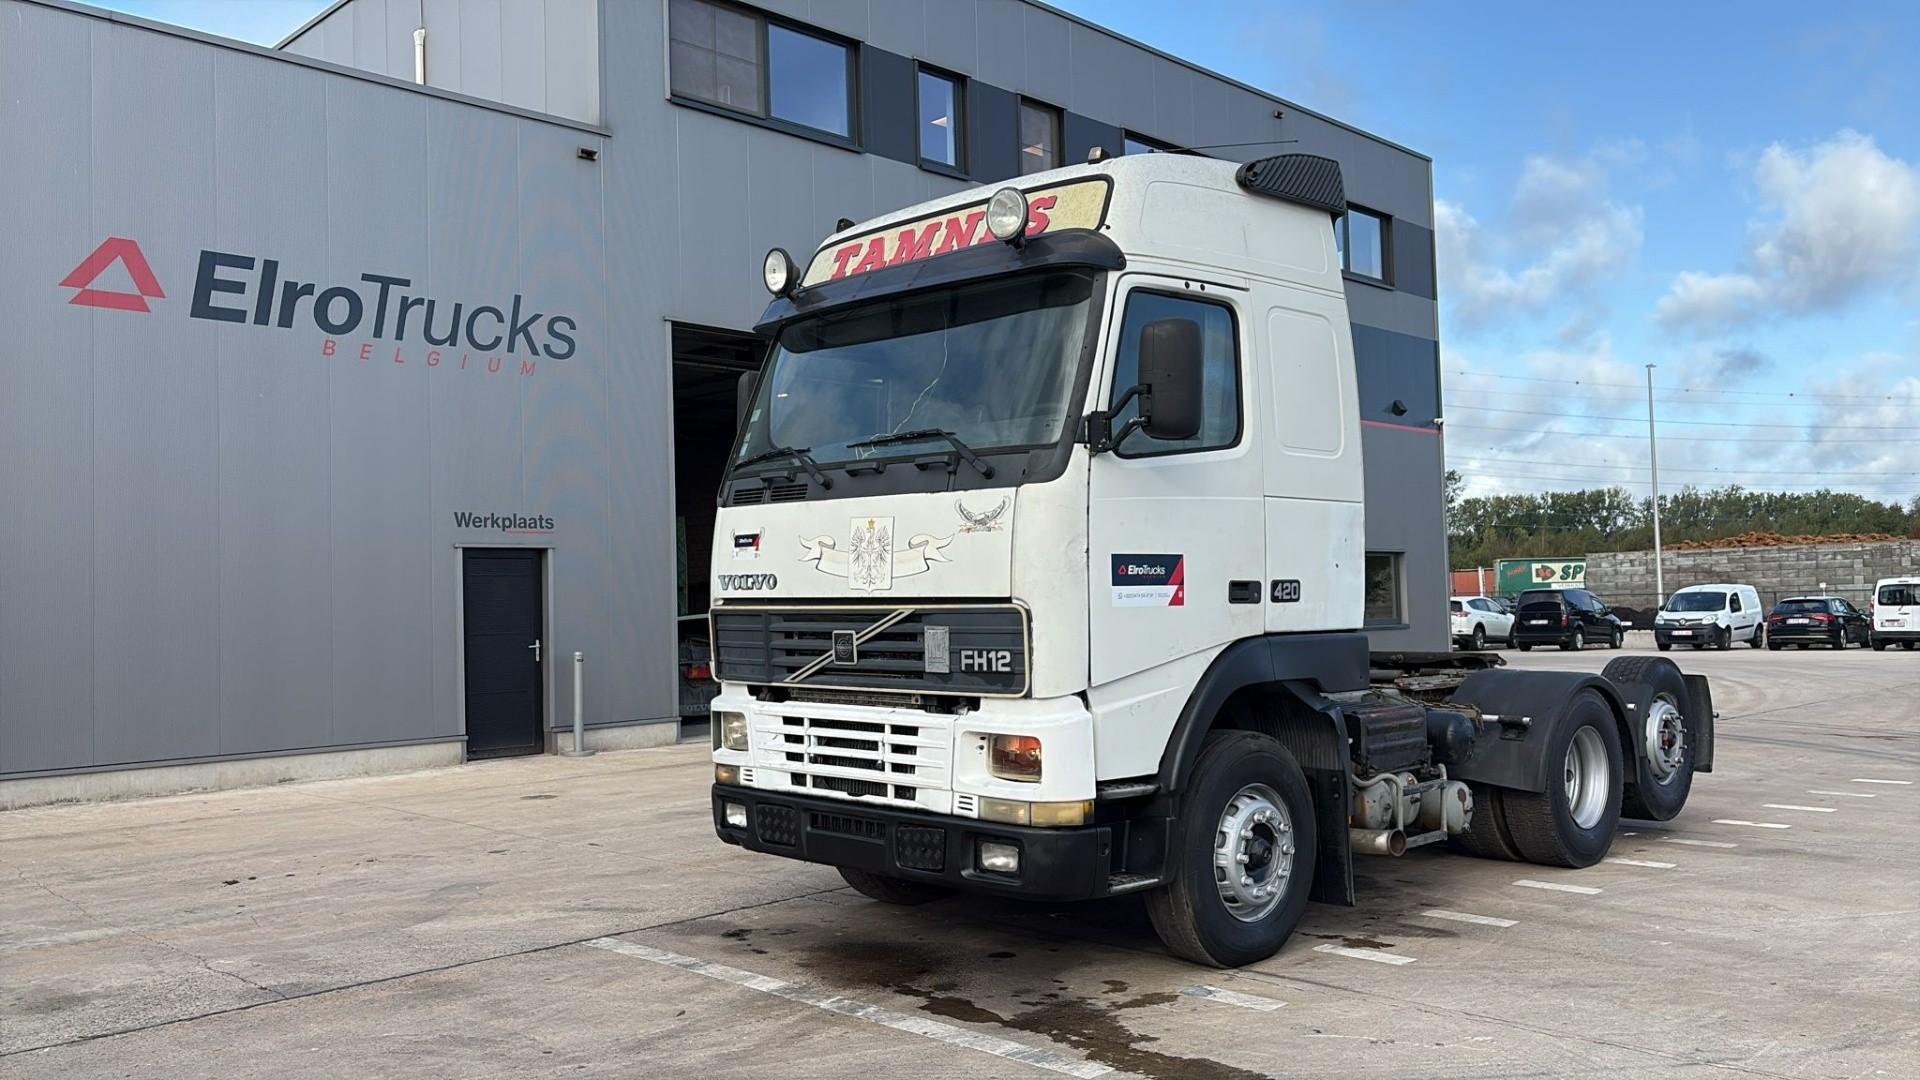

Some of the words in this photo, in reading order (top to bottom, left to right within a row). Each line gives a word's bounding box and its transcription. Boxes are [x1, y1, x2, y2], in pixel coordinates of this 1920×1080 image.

[831, 195, 1057, 280] TAMNS
[190, 249, 577, 360] ElroTrucks
[321, 339, 537, 376] BELGIUM
[454, 511, 555, 531] Werkplaats
[1127, 564, 1167, 575] ElroTrucks
[1559, 564, 1585, 581] SP
[718, 574, 778, 591] VOLVO
[1273, 582, 1299, 600] 420
[960, 649, 1012, 672] FH12
